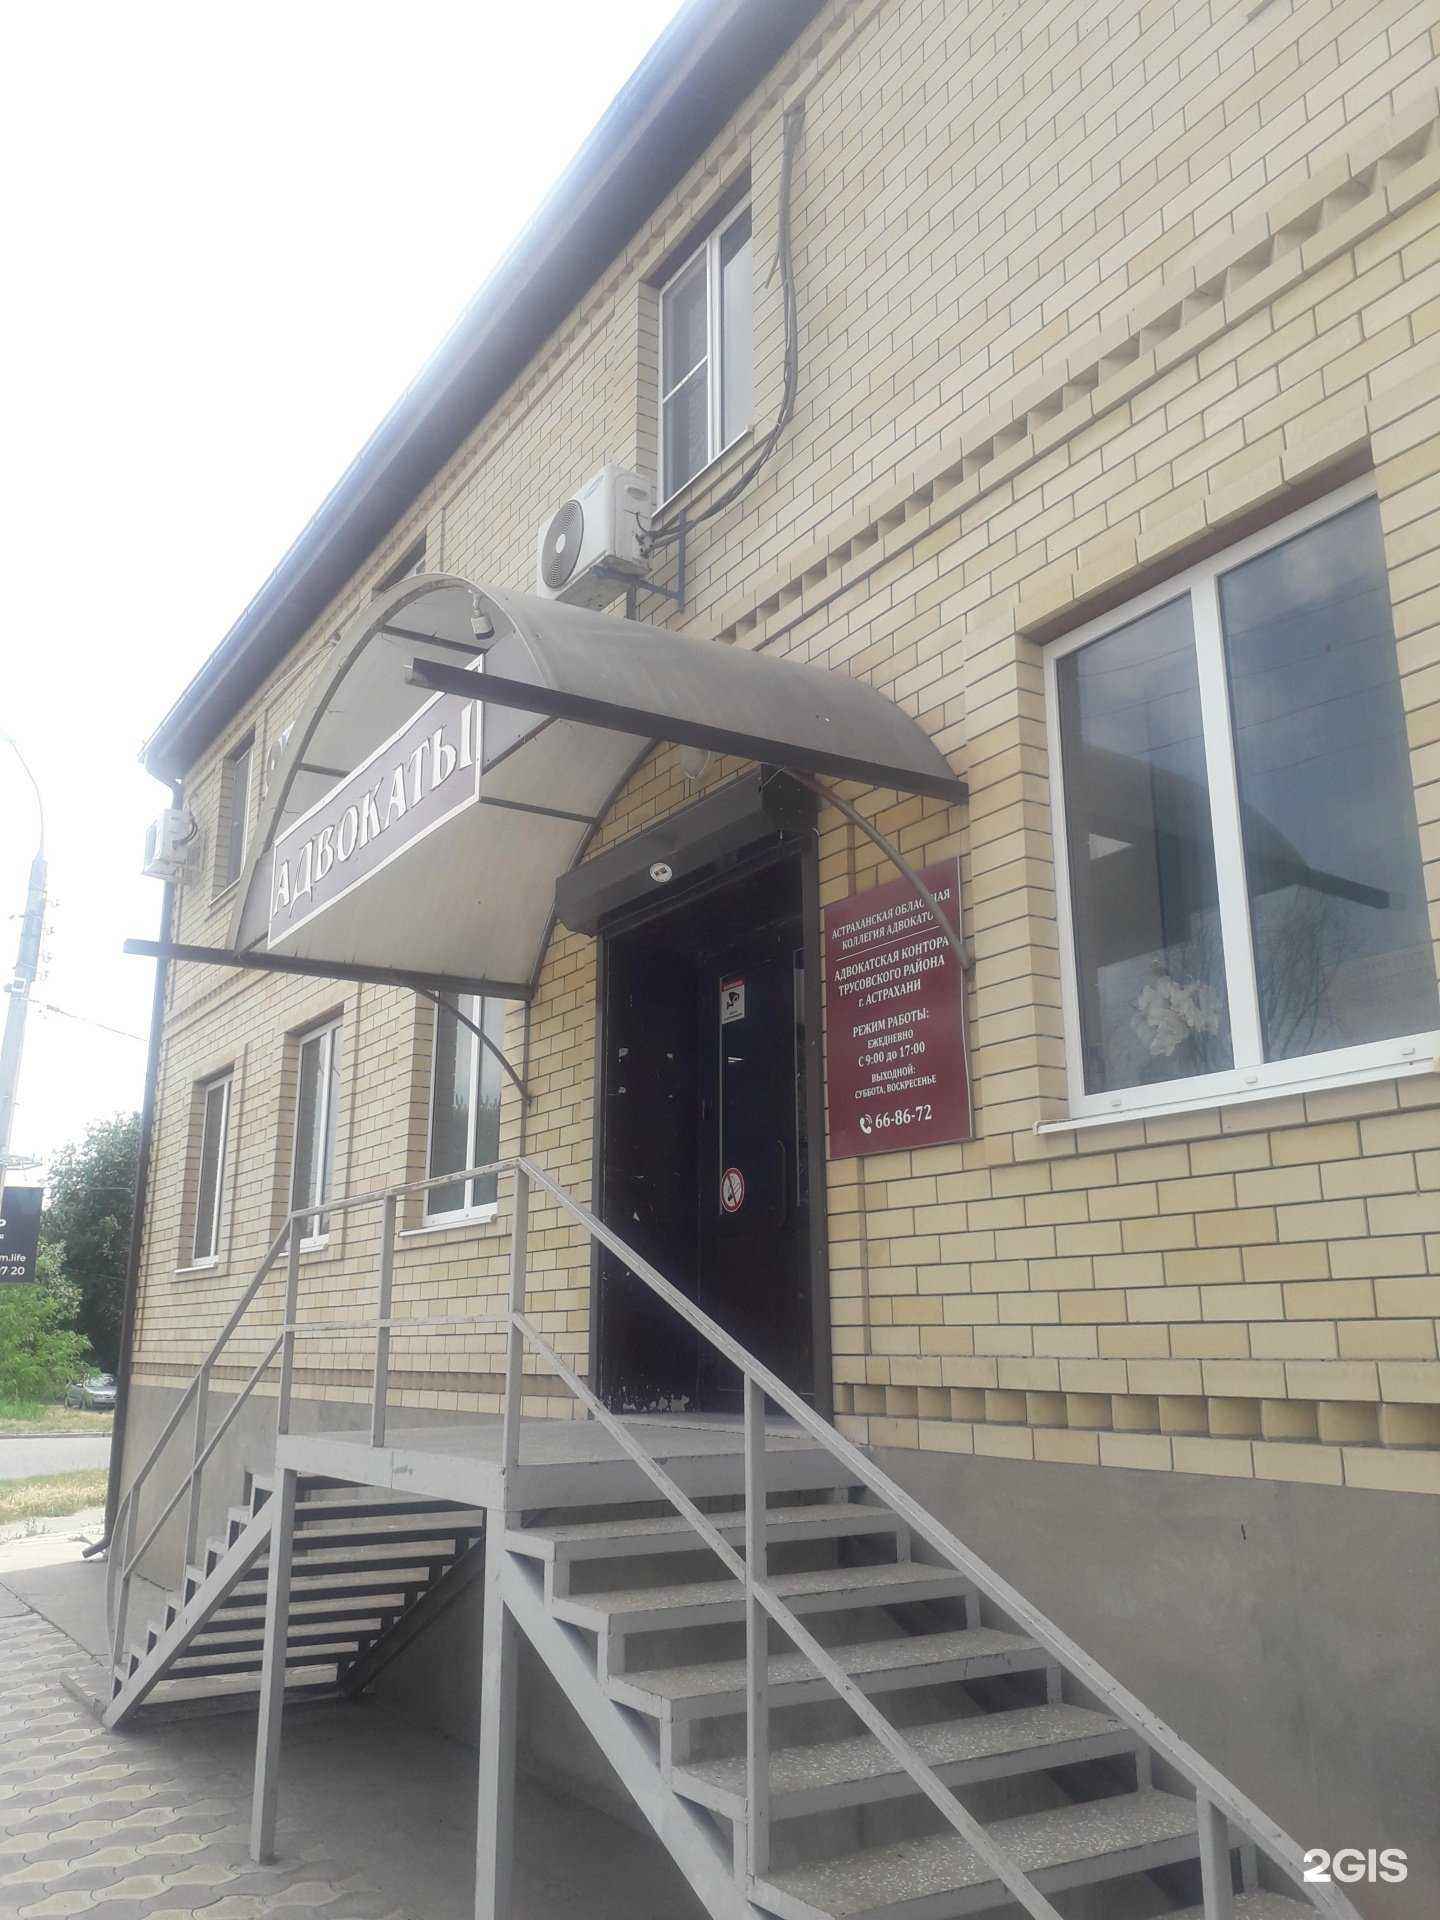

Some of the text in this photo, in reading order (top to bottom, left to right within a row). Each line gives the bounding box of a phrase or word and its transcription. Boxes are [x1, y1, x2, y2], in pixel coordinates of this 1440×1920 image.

[272, 701, 474, 919] АДВОКАТЫ
[832, 888, 951, 940] АСТРАХАНСКАЯ ОБЛАСНАЯ
[842, 926, 885, 951] КОЛЛЕГИЯ
[834, 935, 950, 982] АДВОКАТСКАЯ КОНТОРА
[838, 954, 945, 997] ТРУСОВСКОГО РАЙОНА
[865, 978, 921, 1006] АСТРАХАНИ
[853, 1007, 930, 1038] РЕЖИМ РАБОТЫ:
[867, 1029, 914, 1049] ЕЖЕДНЕВНО
[865, 1051, 885, 1067] 9:00
[886, 1051, 898, 1063] до
[899, 1041, 926, 1058] 17:00
[871, 1063, 916, 1083] ВЫХОДНОЙ:
[855, 1074, 937, 1099] СУББОТА, ВОСКРЕСЕНЬЕ
[875, 1104, 932, 1129] 66-86-72
[10, 1266, 25, 1275] 20
